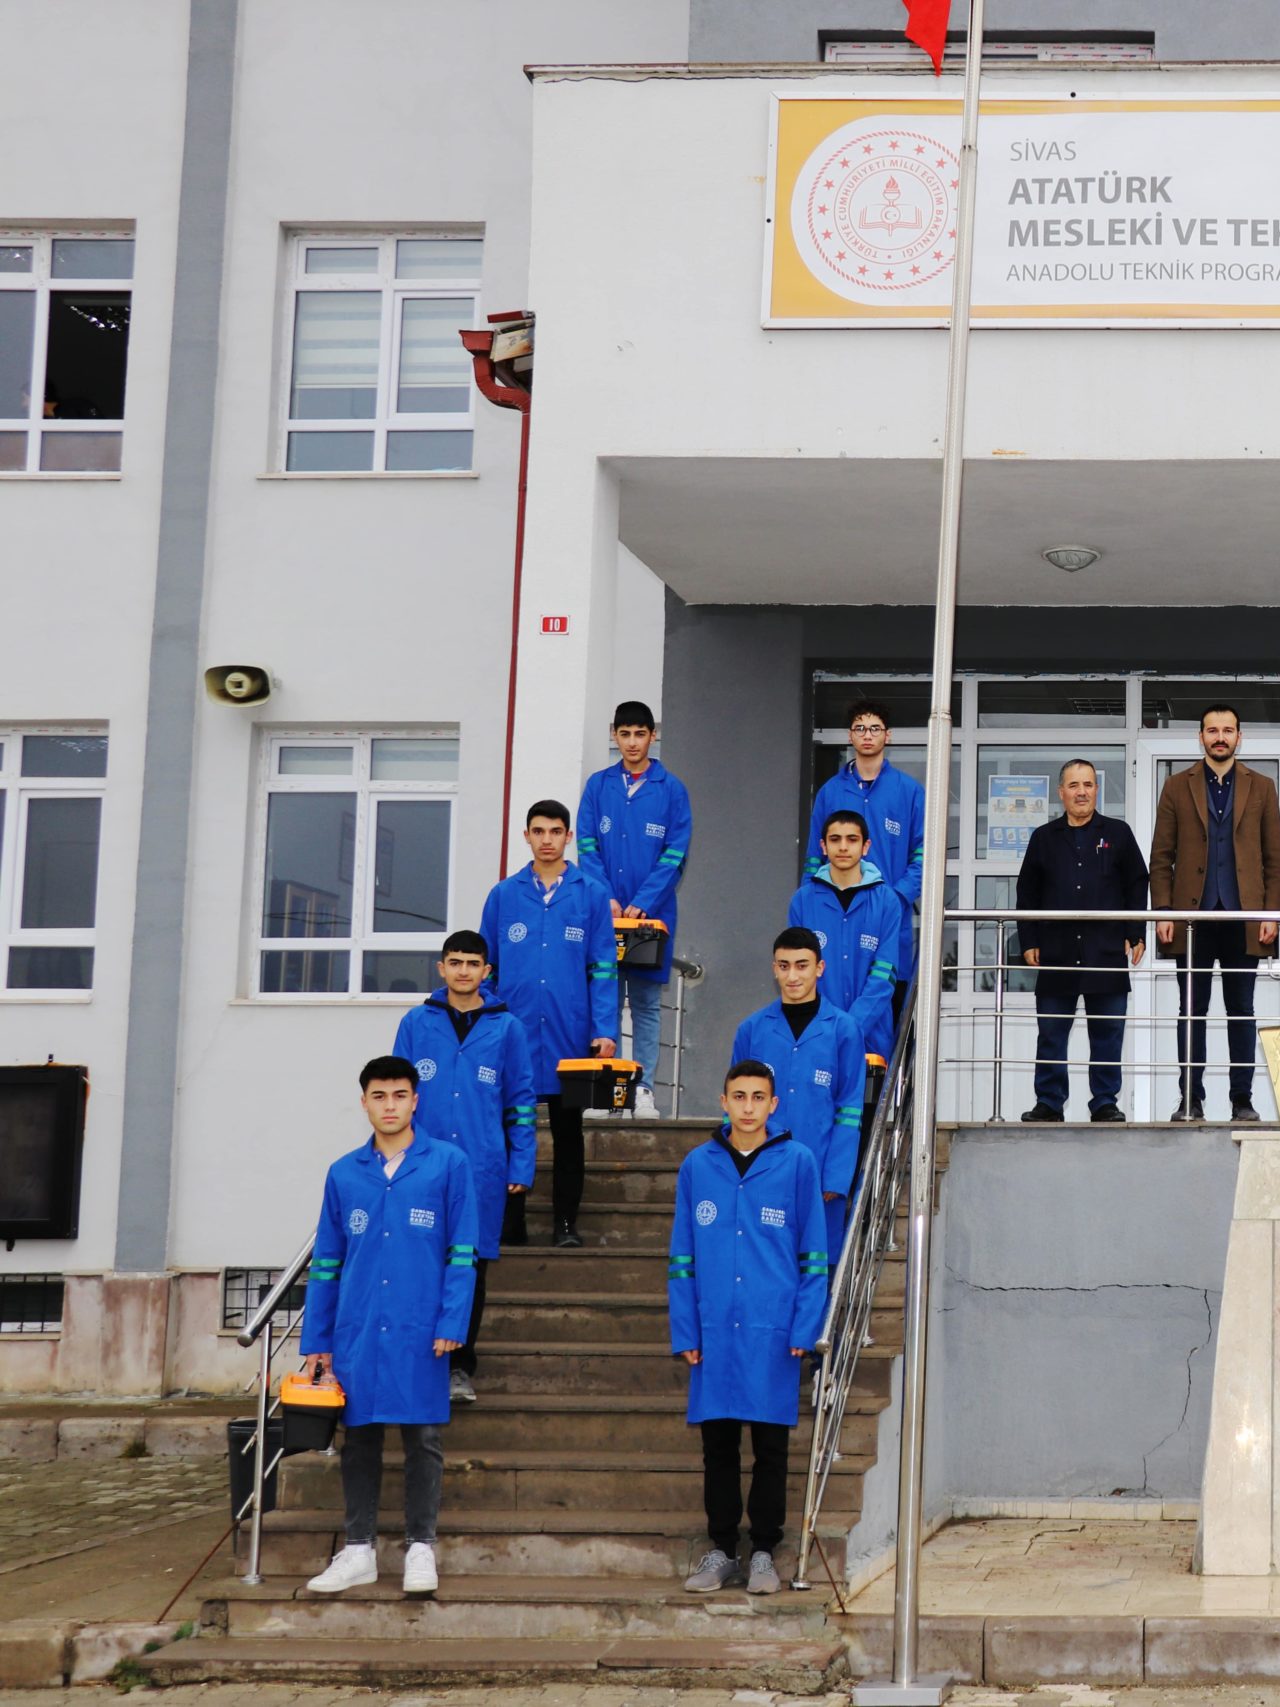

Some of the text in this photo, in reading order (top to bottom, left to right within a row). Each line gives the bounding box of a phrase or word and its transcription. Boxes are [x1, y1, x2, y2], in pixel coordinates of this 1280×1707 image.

[1010, 138, 1077, 162] SİVAS
[1007, 170, 1173, 206] ATATÜRK
[839, 223, 879, 259] TÜRKİYE
[1007, 211, 1163, 248] MESLEKİ
[1171, 218, 1219, 246] VE
[1006, 263, 1114, 282] ANADOLU
[1119, 259, 1195, 281] TEKNİK
[549, 618, 561, 632] 10
